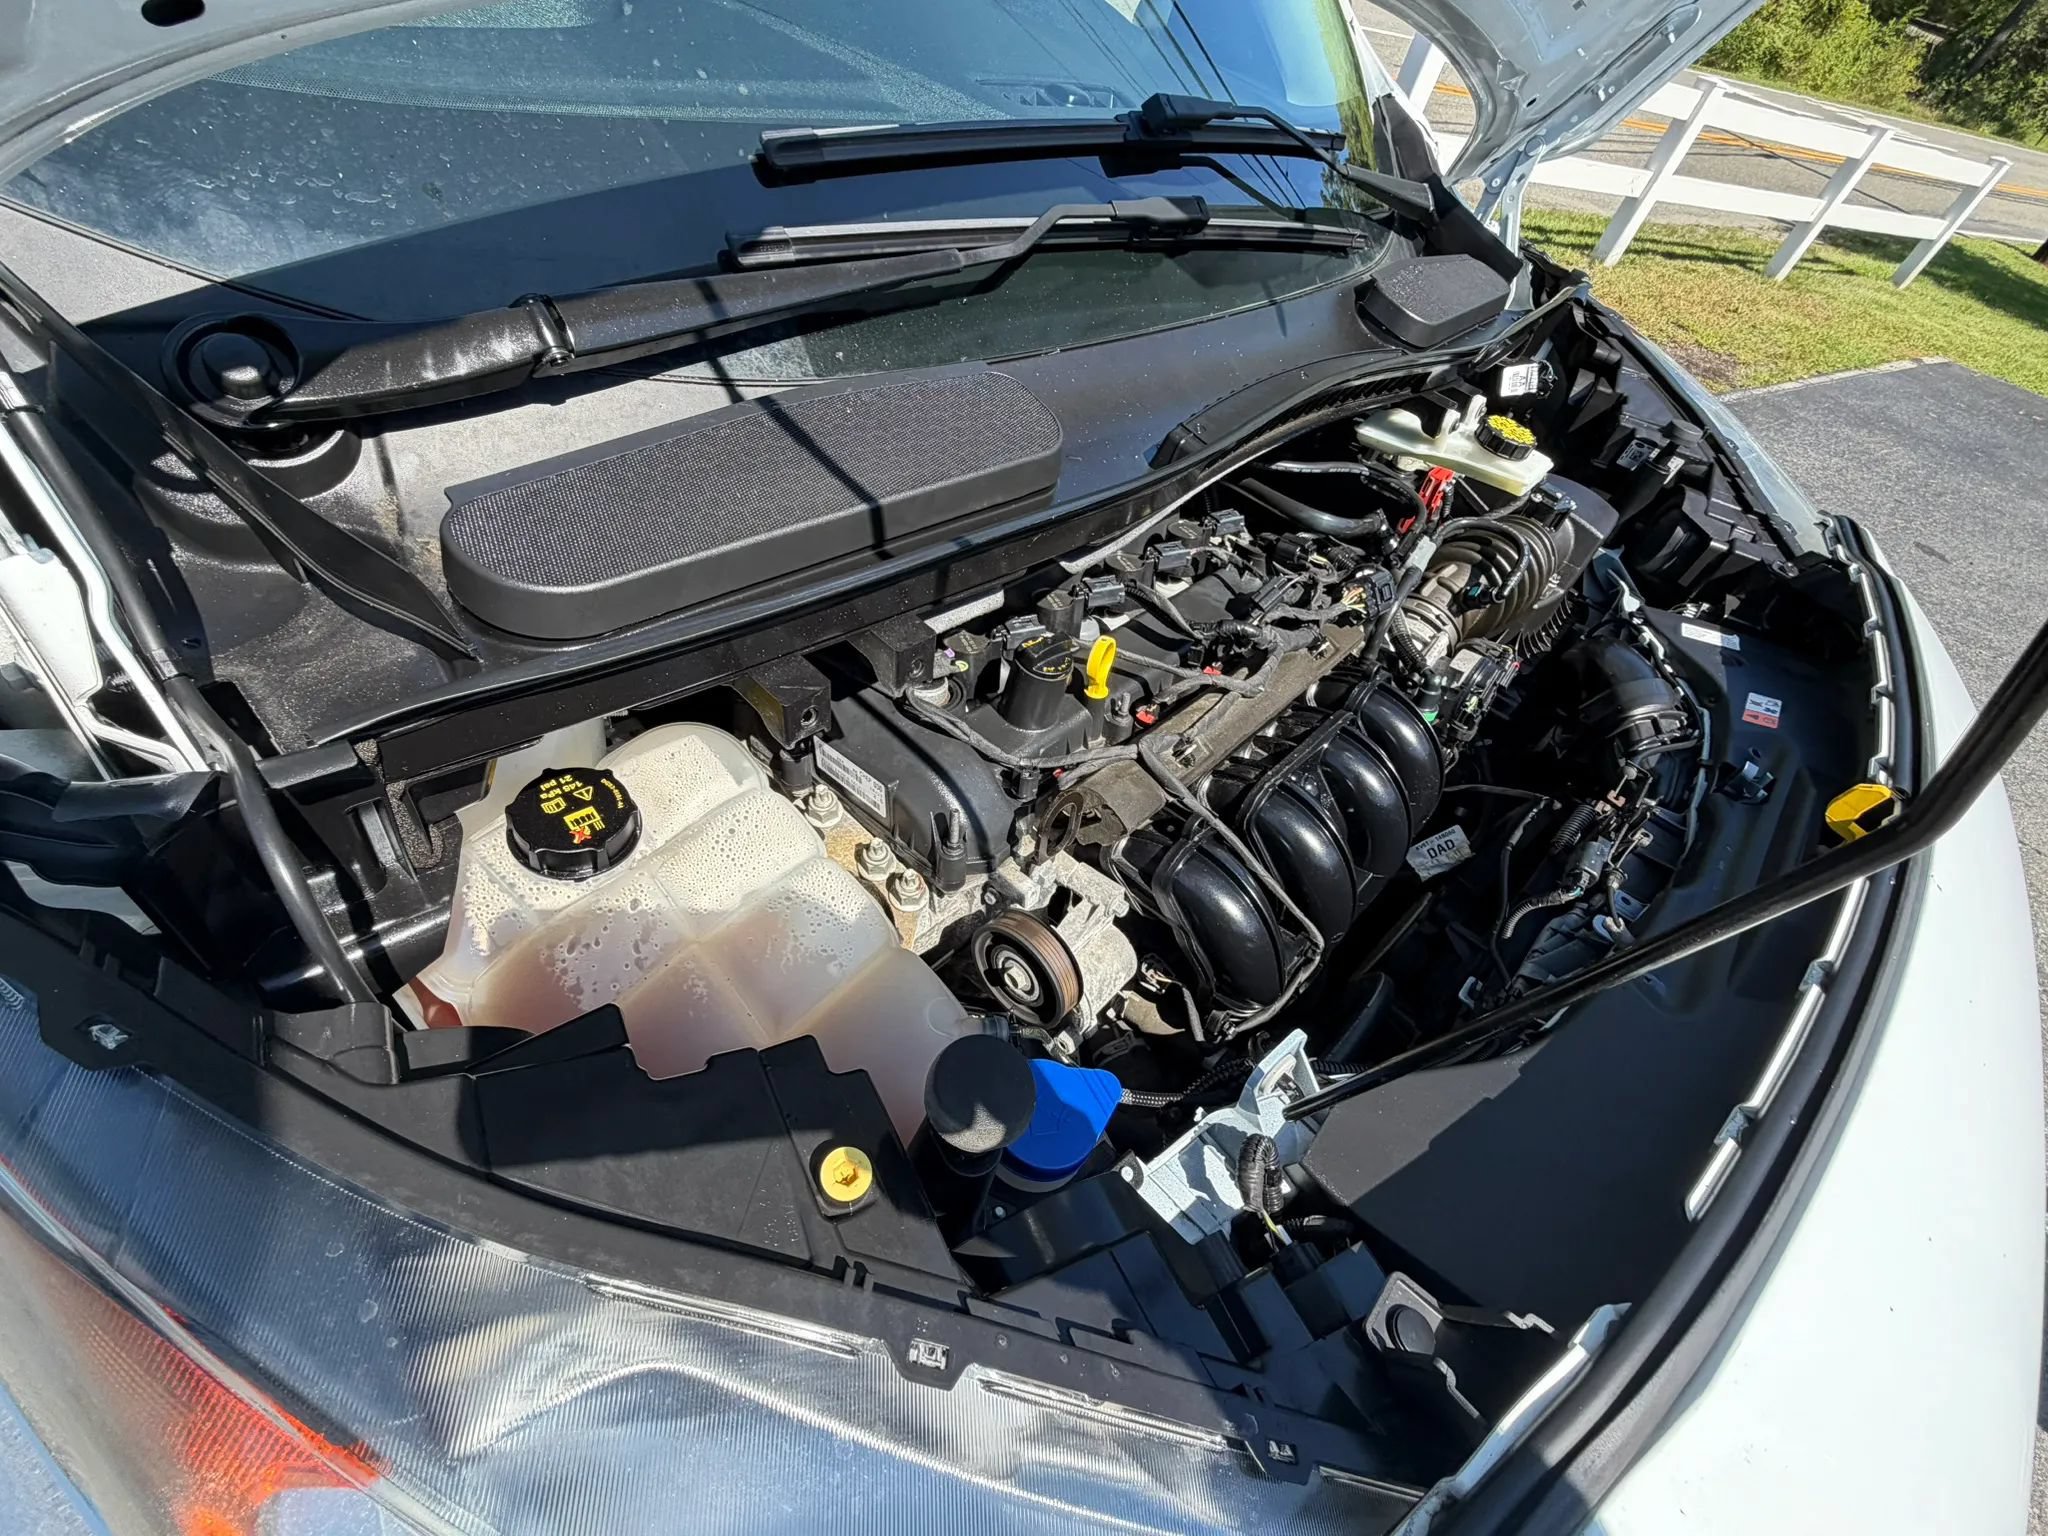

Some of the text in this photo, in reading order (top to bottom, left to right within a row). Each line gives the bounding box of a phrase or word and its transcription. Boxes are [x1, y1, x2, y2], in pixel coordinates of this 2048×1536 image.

[540, 775, 573, 791] 21 psi
[540, 788, 562, 799] kPa
[1427, 839, 1455, 858] DAD
